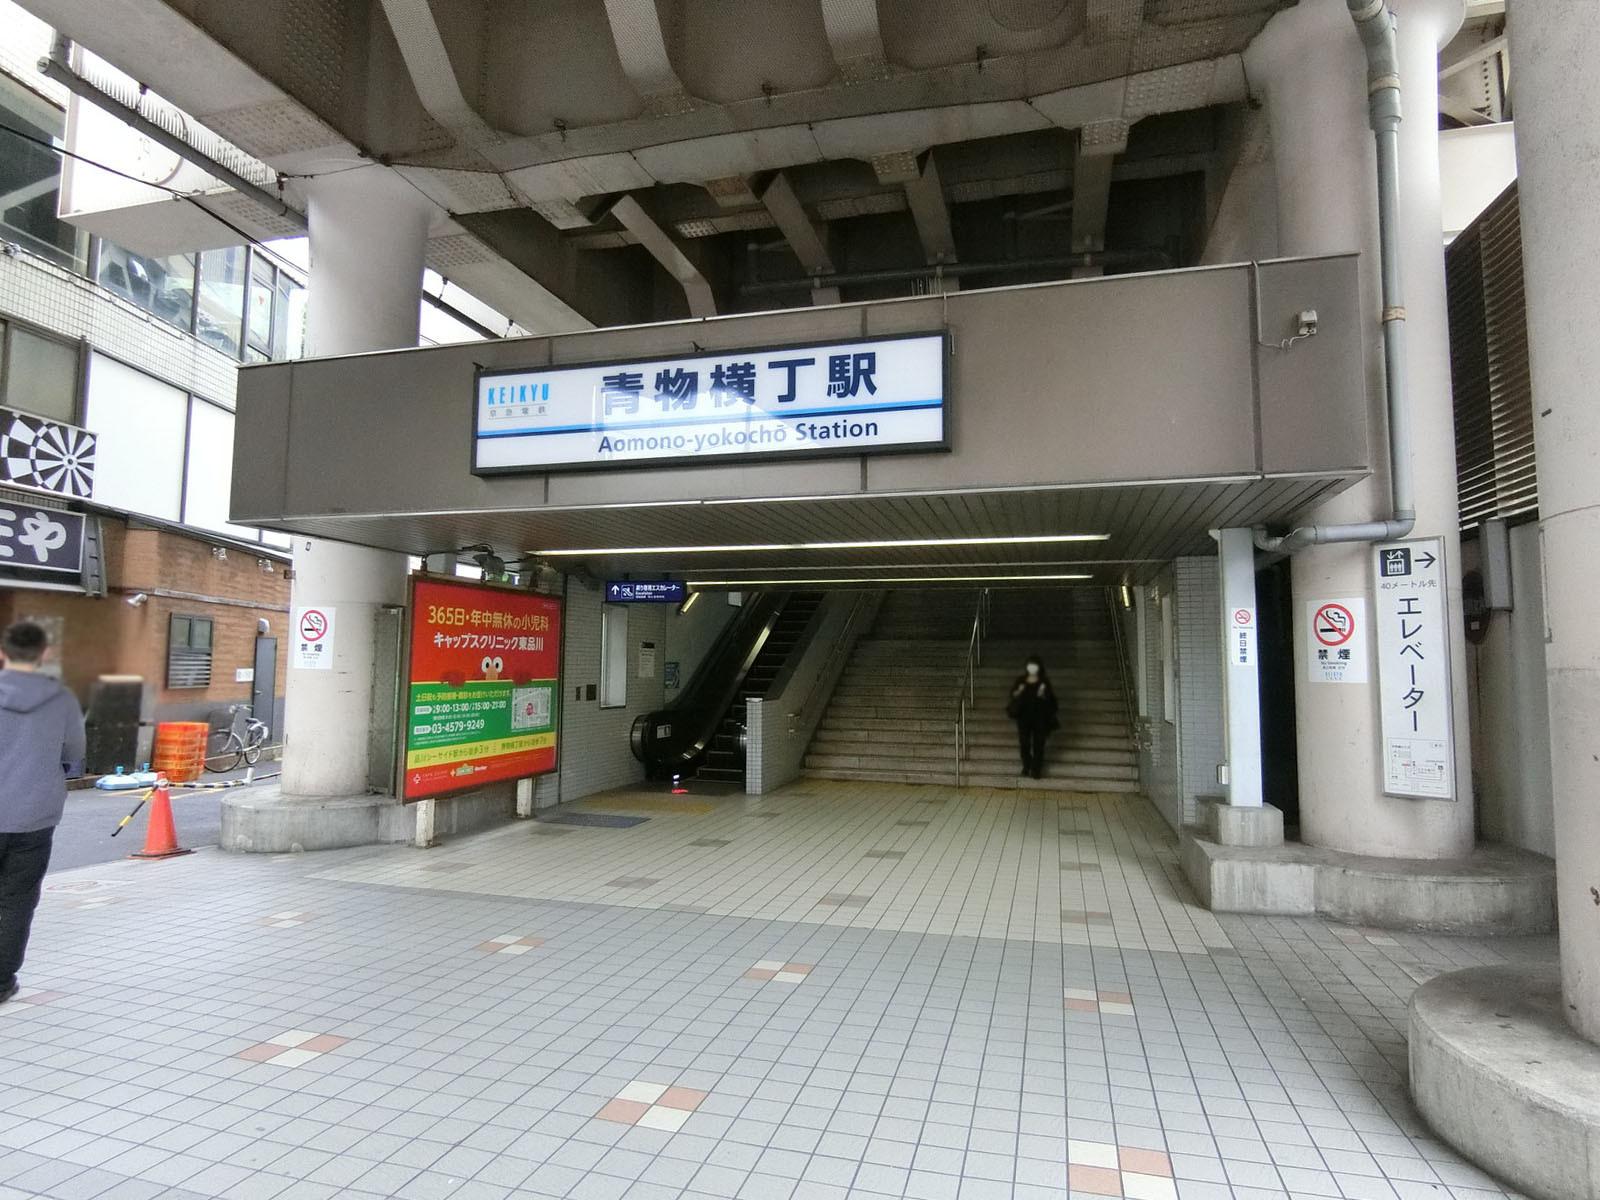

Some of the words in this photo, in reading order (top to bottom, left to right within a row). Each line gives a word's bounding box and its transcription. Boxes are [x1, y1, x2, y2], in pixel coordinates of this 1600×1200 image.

[601, 352, 877, 415] 青物横丁駅
[488, 384, 549, 405] KEIKYU
[598, 424, 787, 453] Aomono-yokochō
[795, 420, 878, 442] Station
[1380, 579, 1437, 589] 40メートル先
[428, 605, 549, 631] 365日・年中無休の小児科
[301, 643, 323, 652] 禁煙
[433, 631, 544, 652] キャップスクリニック東品川
[1318, 649, 1350, 660] 禁煙
[1397, 597, 1425, 732] エレベーター
[432, 719, 485, 734] 03-4579-9249
